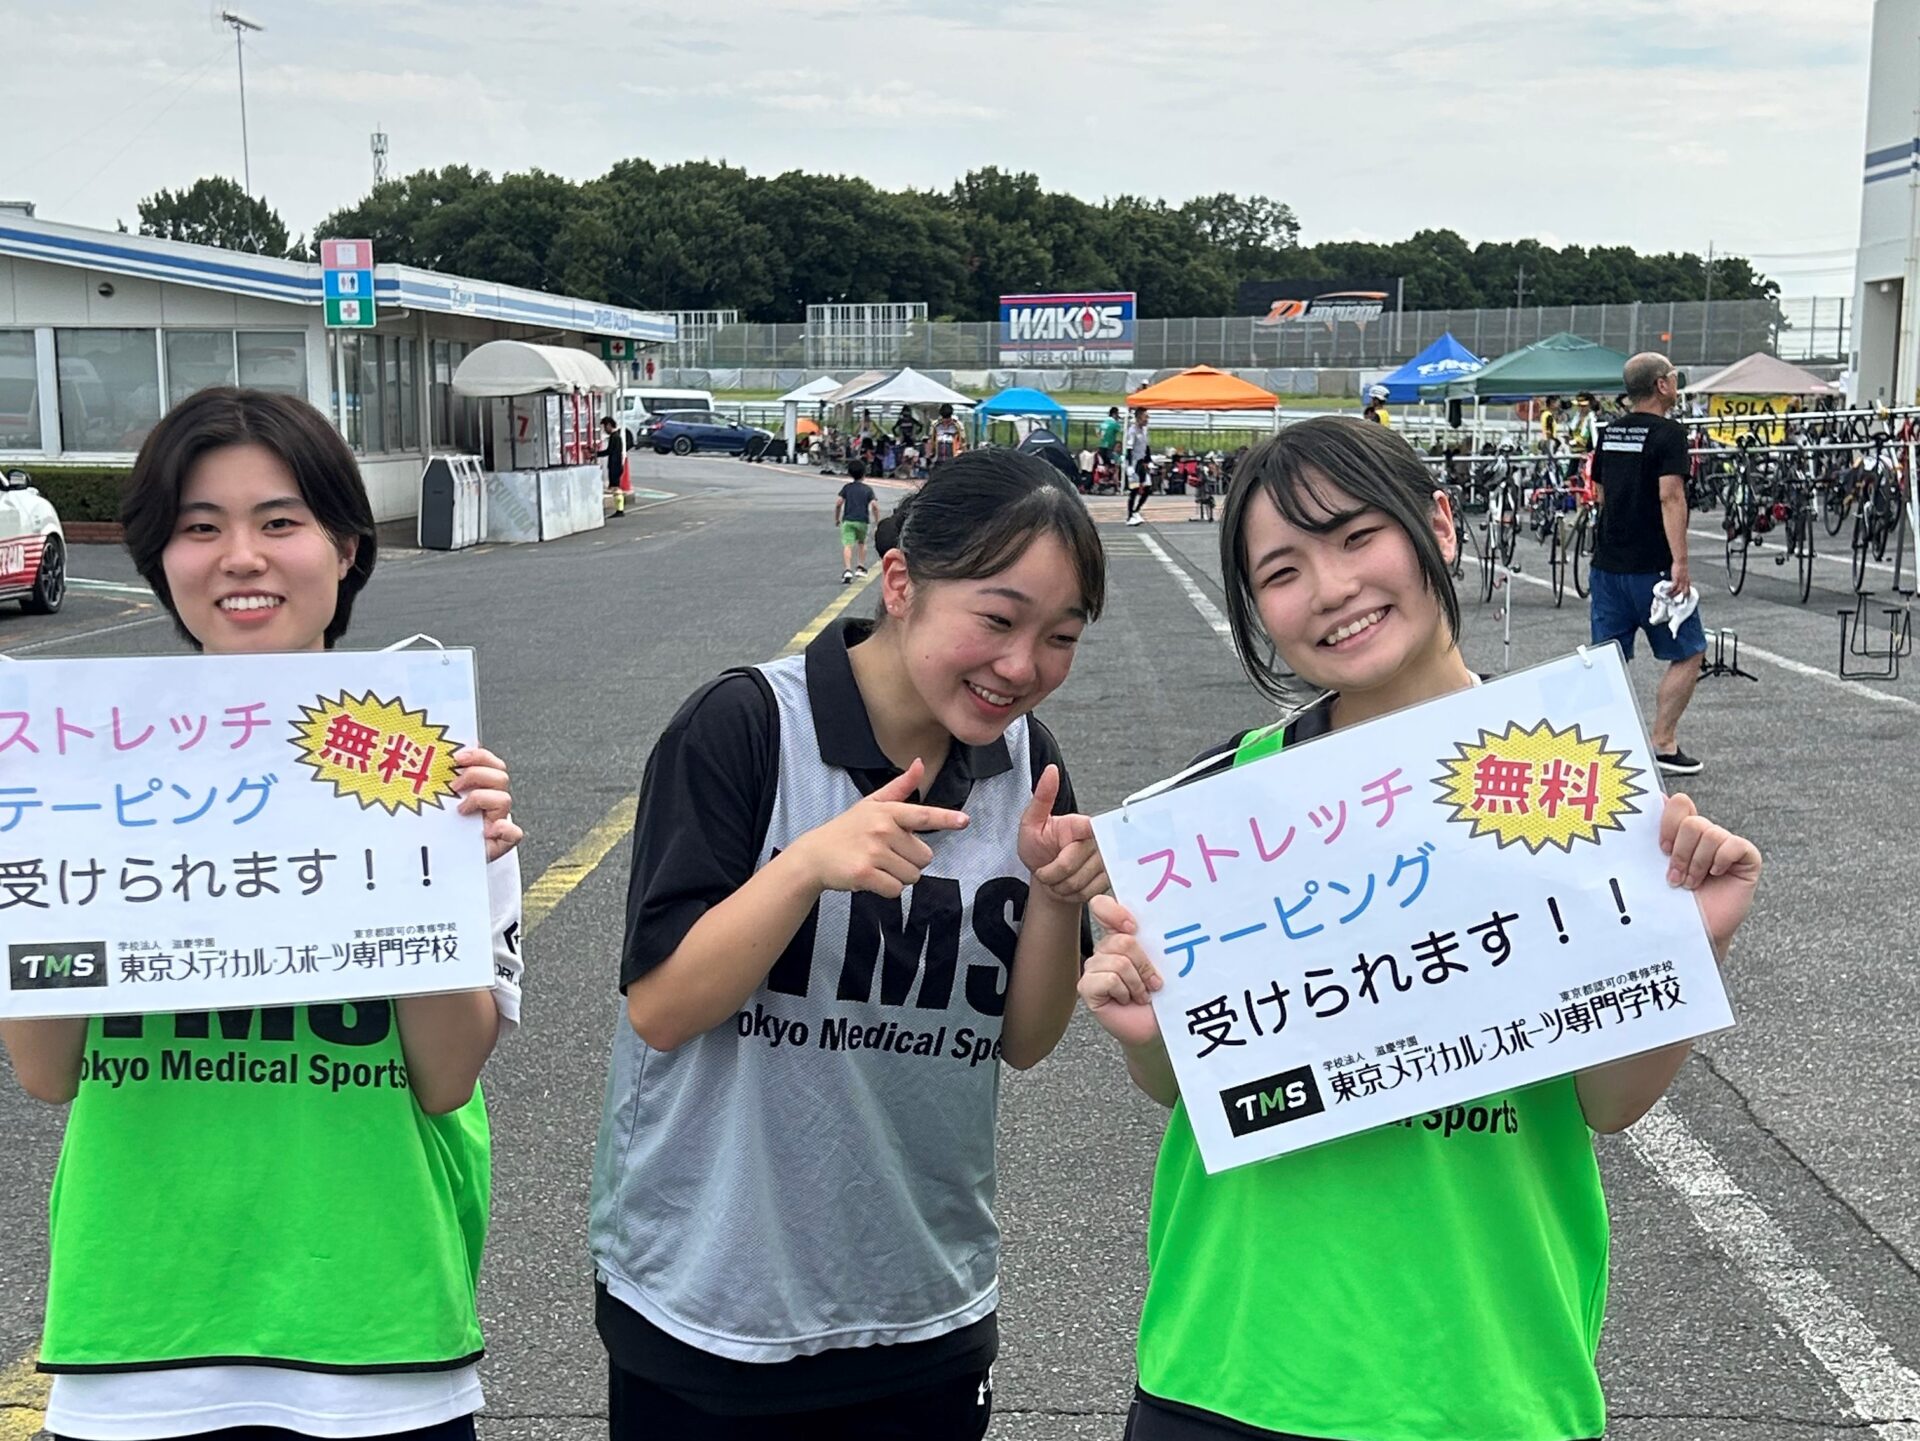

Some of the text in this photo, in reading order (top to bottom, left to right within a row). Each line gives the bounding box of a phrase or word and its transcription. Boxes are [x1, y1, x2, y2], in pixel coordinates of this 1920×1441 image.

[1010, 306, 1123, 340] WAKO'S
[1723, 400, 1774, 416] SOLA
[0, 702, 271, 755] ストレッチ
[319, 713, 436, 795] 無料
[0, 773, 279, 832] テーピング
[1471, 754, 1601, 821] 無料
[1138, 767, 1412, 902] ストレッチ
[1164, 841, 1436, 977] テーピング
[19, 952, 96, 980] TMS
[1186, 878, 1633, 1059] 受けられます！！
[1559, 960, 1675, 1002] 東京都認可の専修学校
[738, 1003, 809, 1047] okyo
[819, 1017, 946, 1058] Medical
[161, 1050, 298, 1086] Medical
[308, 1053, 407, 1092] Sports
[1322, 1052, 1365, 1071] 学校法人
[1235, 1080, 1307, 1121] TMS
